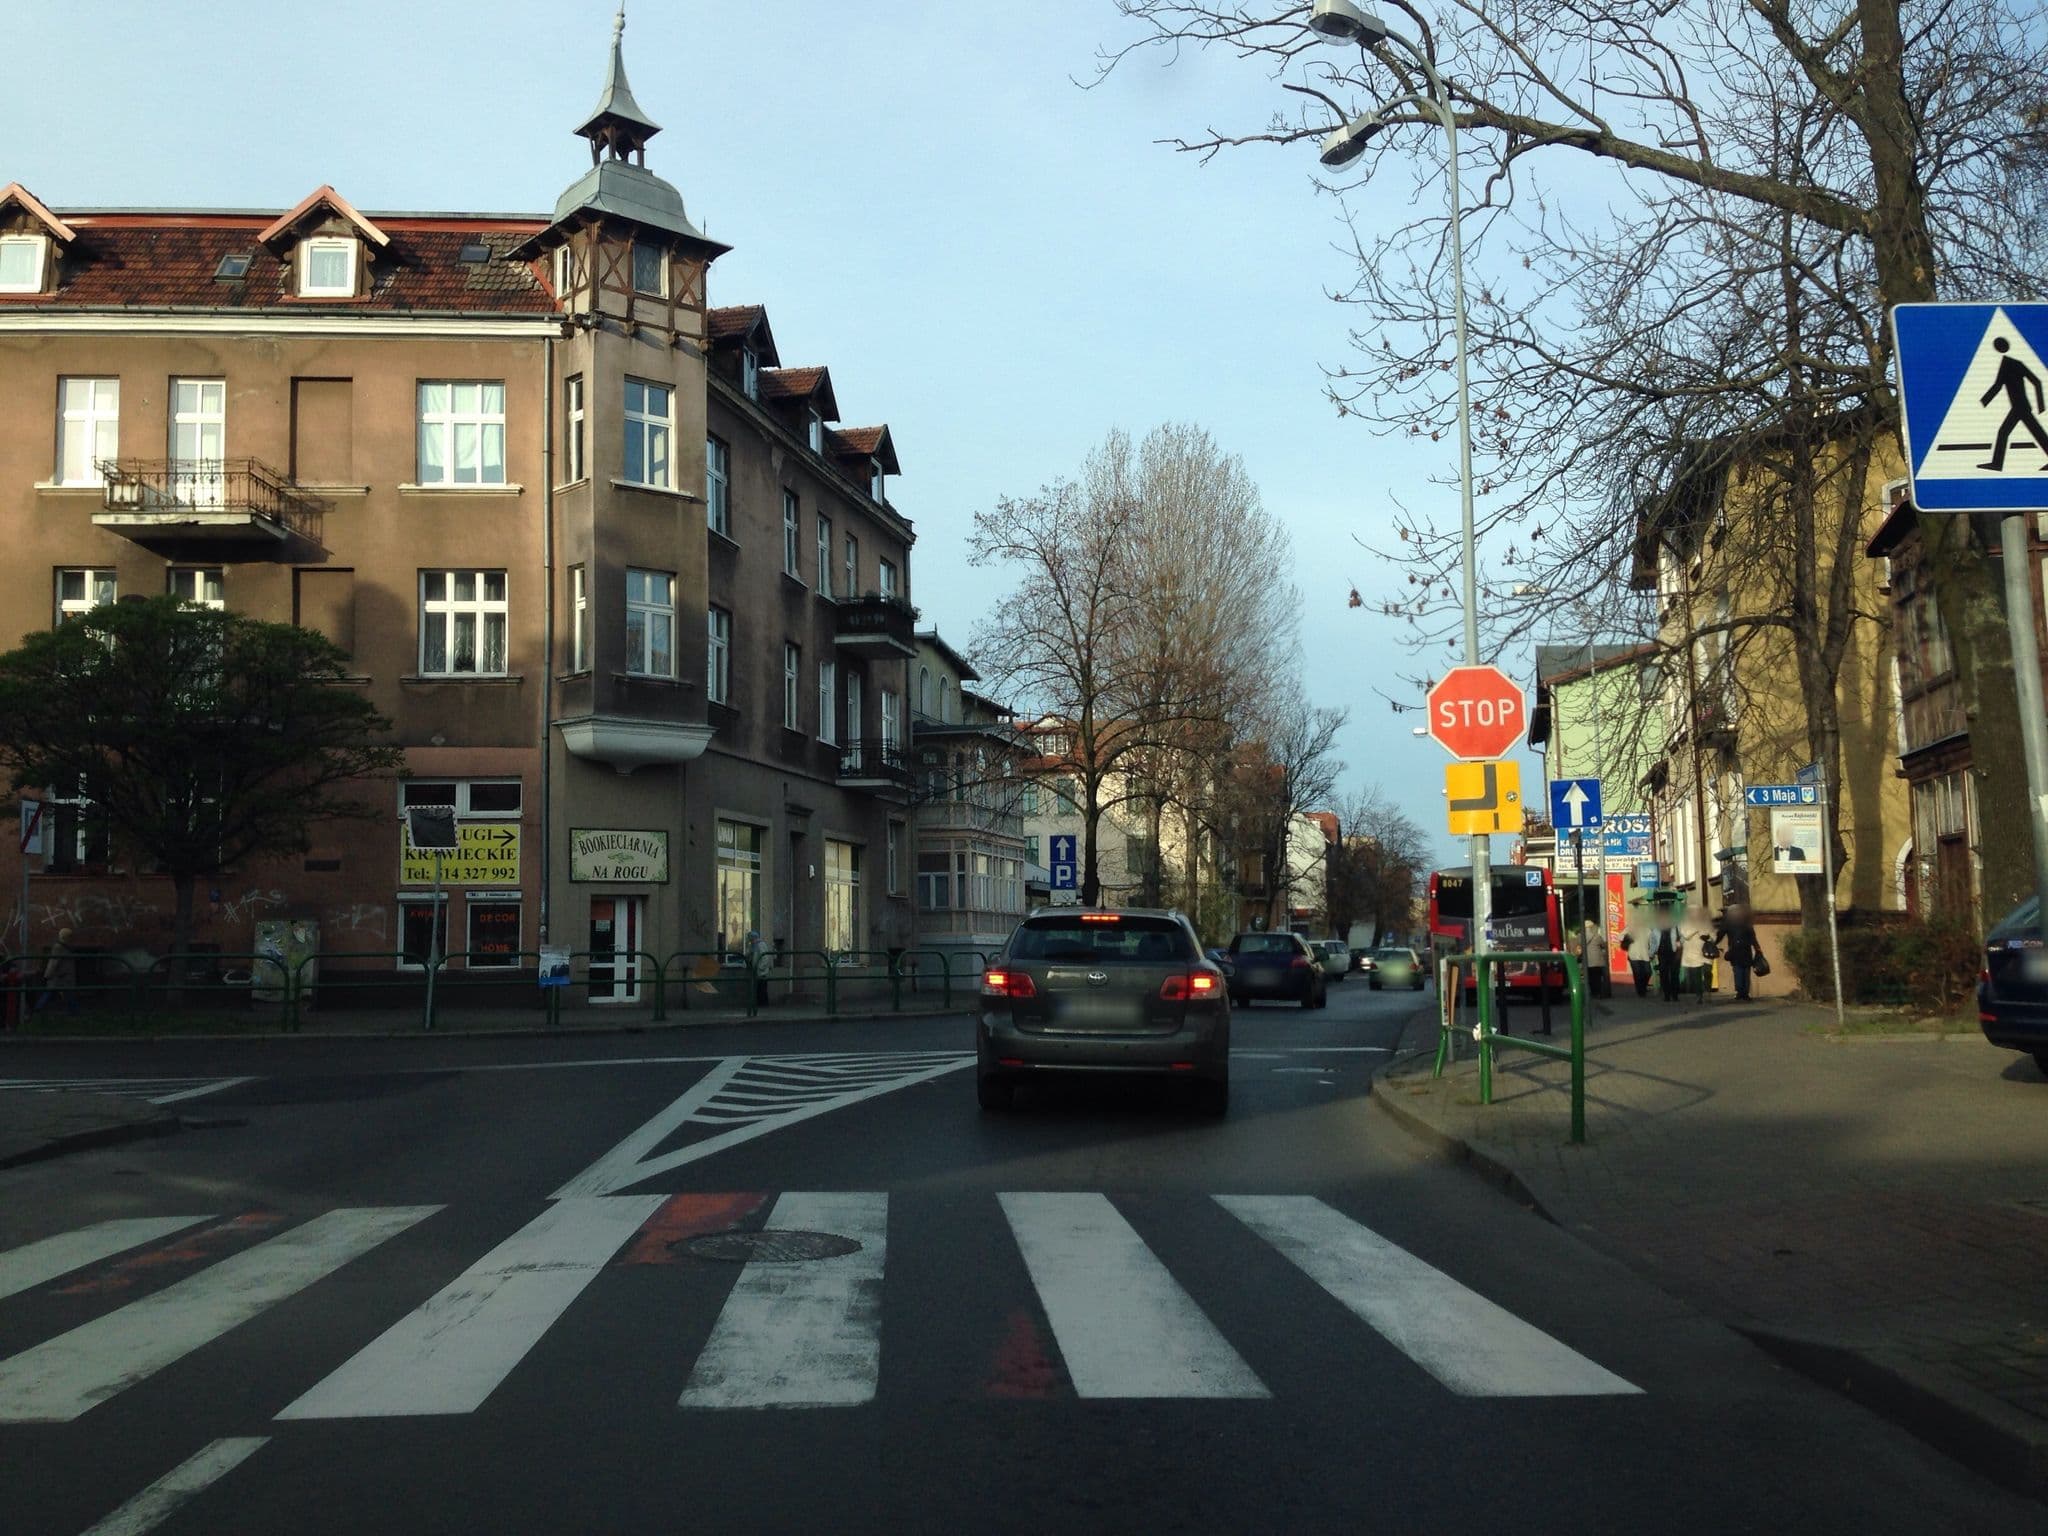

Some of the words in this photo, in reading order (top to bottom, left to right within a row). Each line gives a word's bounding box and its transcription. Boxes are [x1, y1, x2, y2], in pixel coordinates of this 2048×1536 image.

[1439, 698, 1516, 728] STOP
[1763, 789, 1769, 802] 3
[1773, 789, 1796, 805] Maja
[578, 834, 659, 859] BOOKIECIARNIA
[404, 868, 430, 880] Tel:
[440, 868, 460, 880] 14
[463, 868, 488, 880] 327
[492, 868, 516, 880] 992
[591, 867, 609, 879] NA
[614, 867, 648, 879] ROGU
[1056, 865, 1071, 886] P
